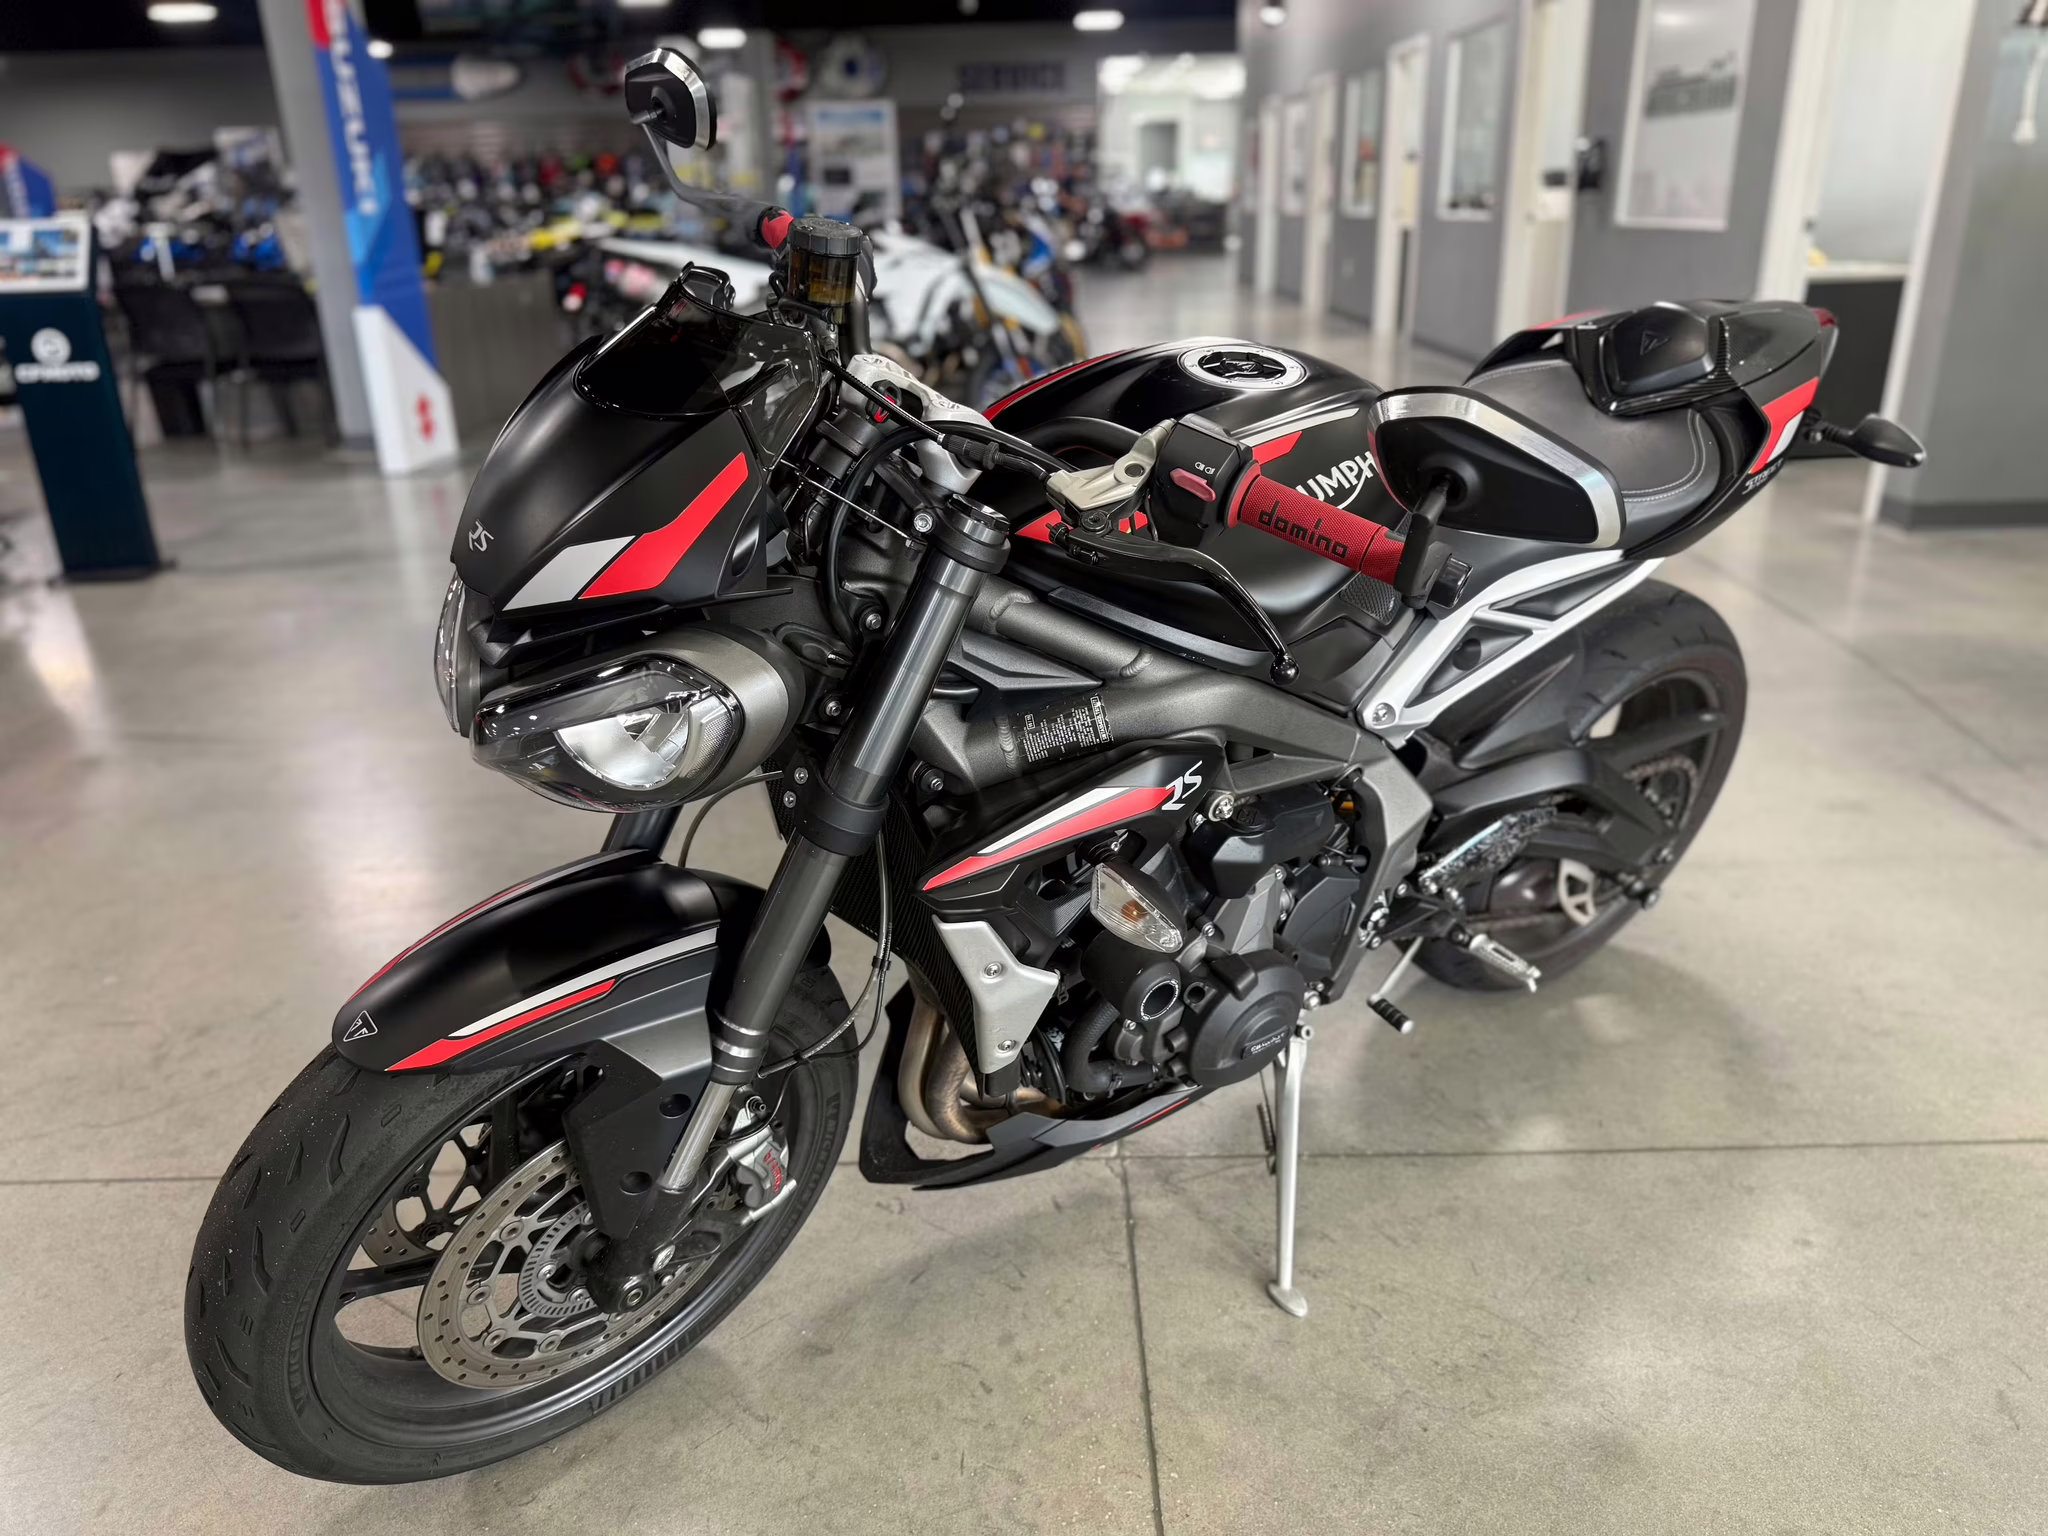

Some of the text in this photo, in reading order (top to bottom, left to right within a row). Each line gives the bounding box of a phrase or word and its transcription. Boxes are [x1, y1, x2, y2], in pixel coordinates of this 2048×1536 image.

[319, 0, 379, 216] SUZUKI
[1295, 451, 1379, 502] UMPH
[468, 518, 495, 552] RS
[1258, 499, 1348, 559] domino
[1161, 760, 1203, 811] RS
